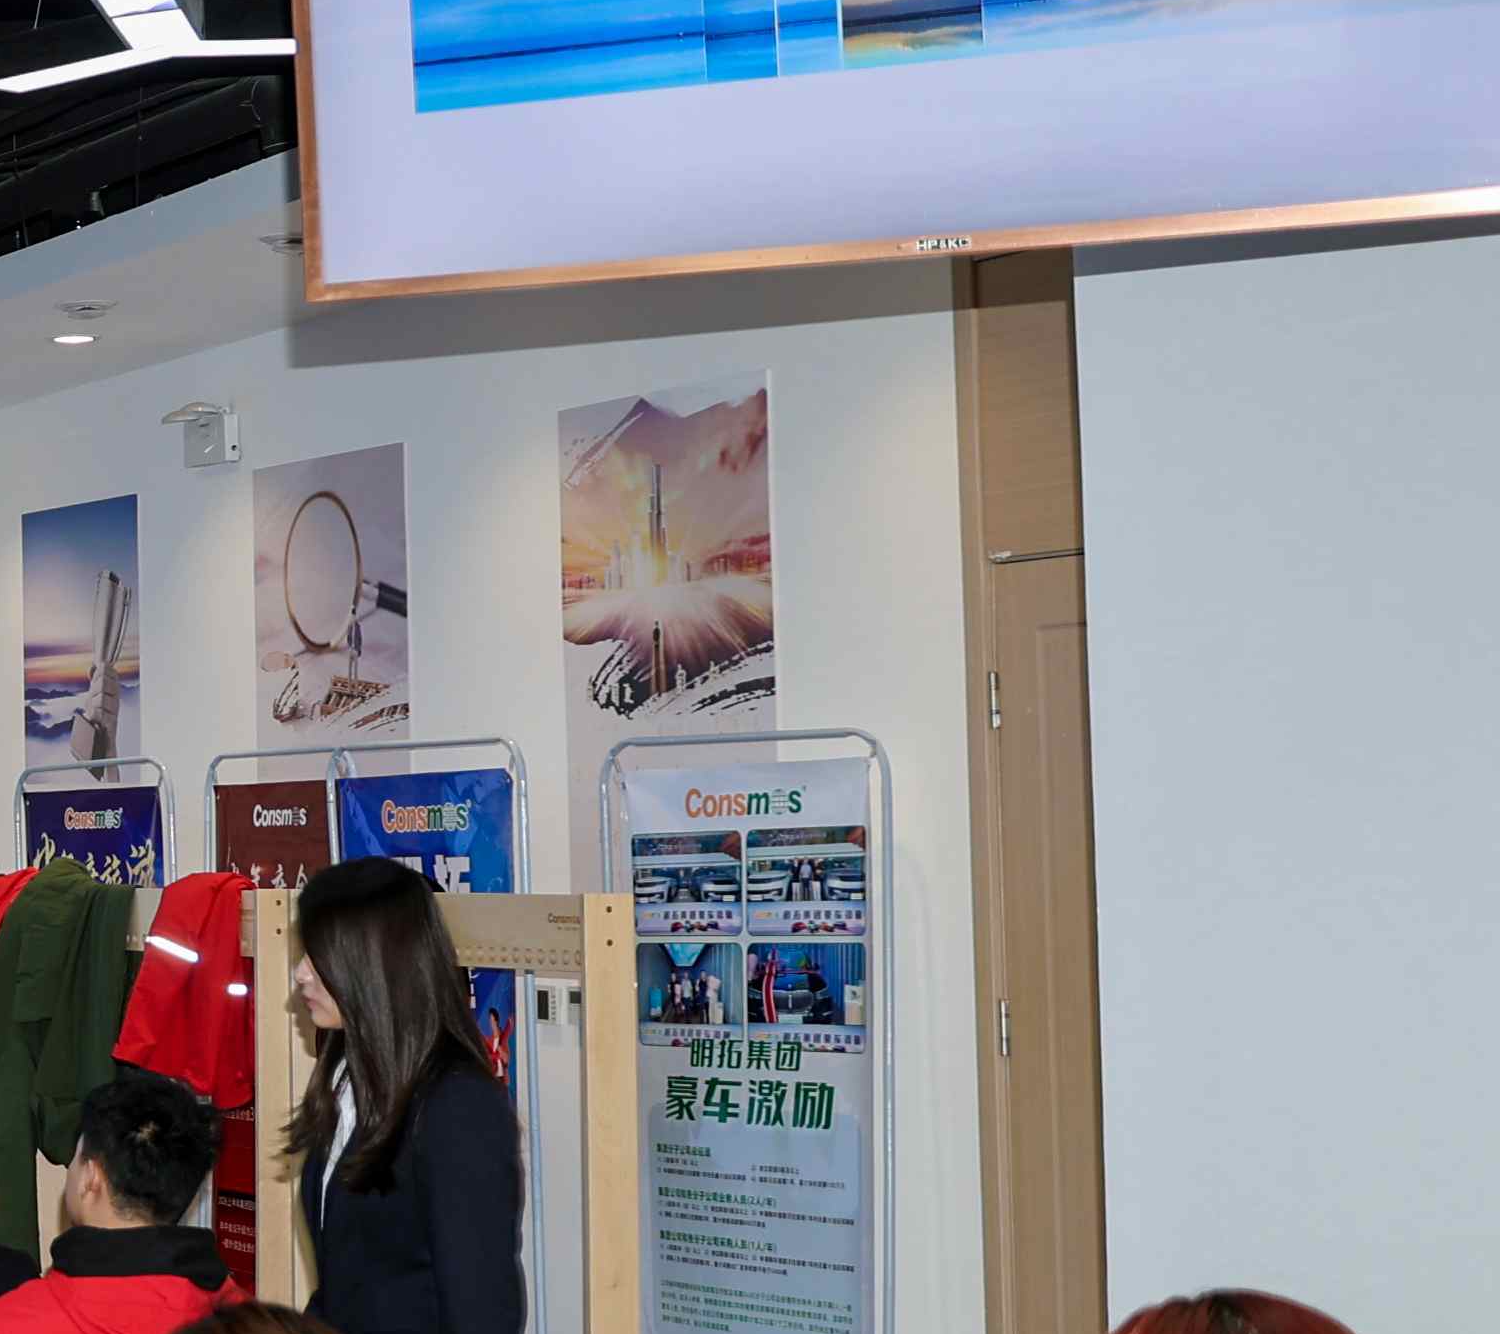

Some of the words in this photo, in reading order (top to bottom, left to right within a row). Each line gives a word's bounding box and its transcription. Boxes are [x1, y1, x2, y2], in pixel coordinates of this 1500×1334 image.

[689, 1038, 803, 1072] 明拓集团
[665, 1075, 836, 1131] 豪车激励
